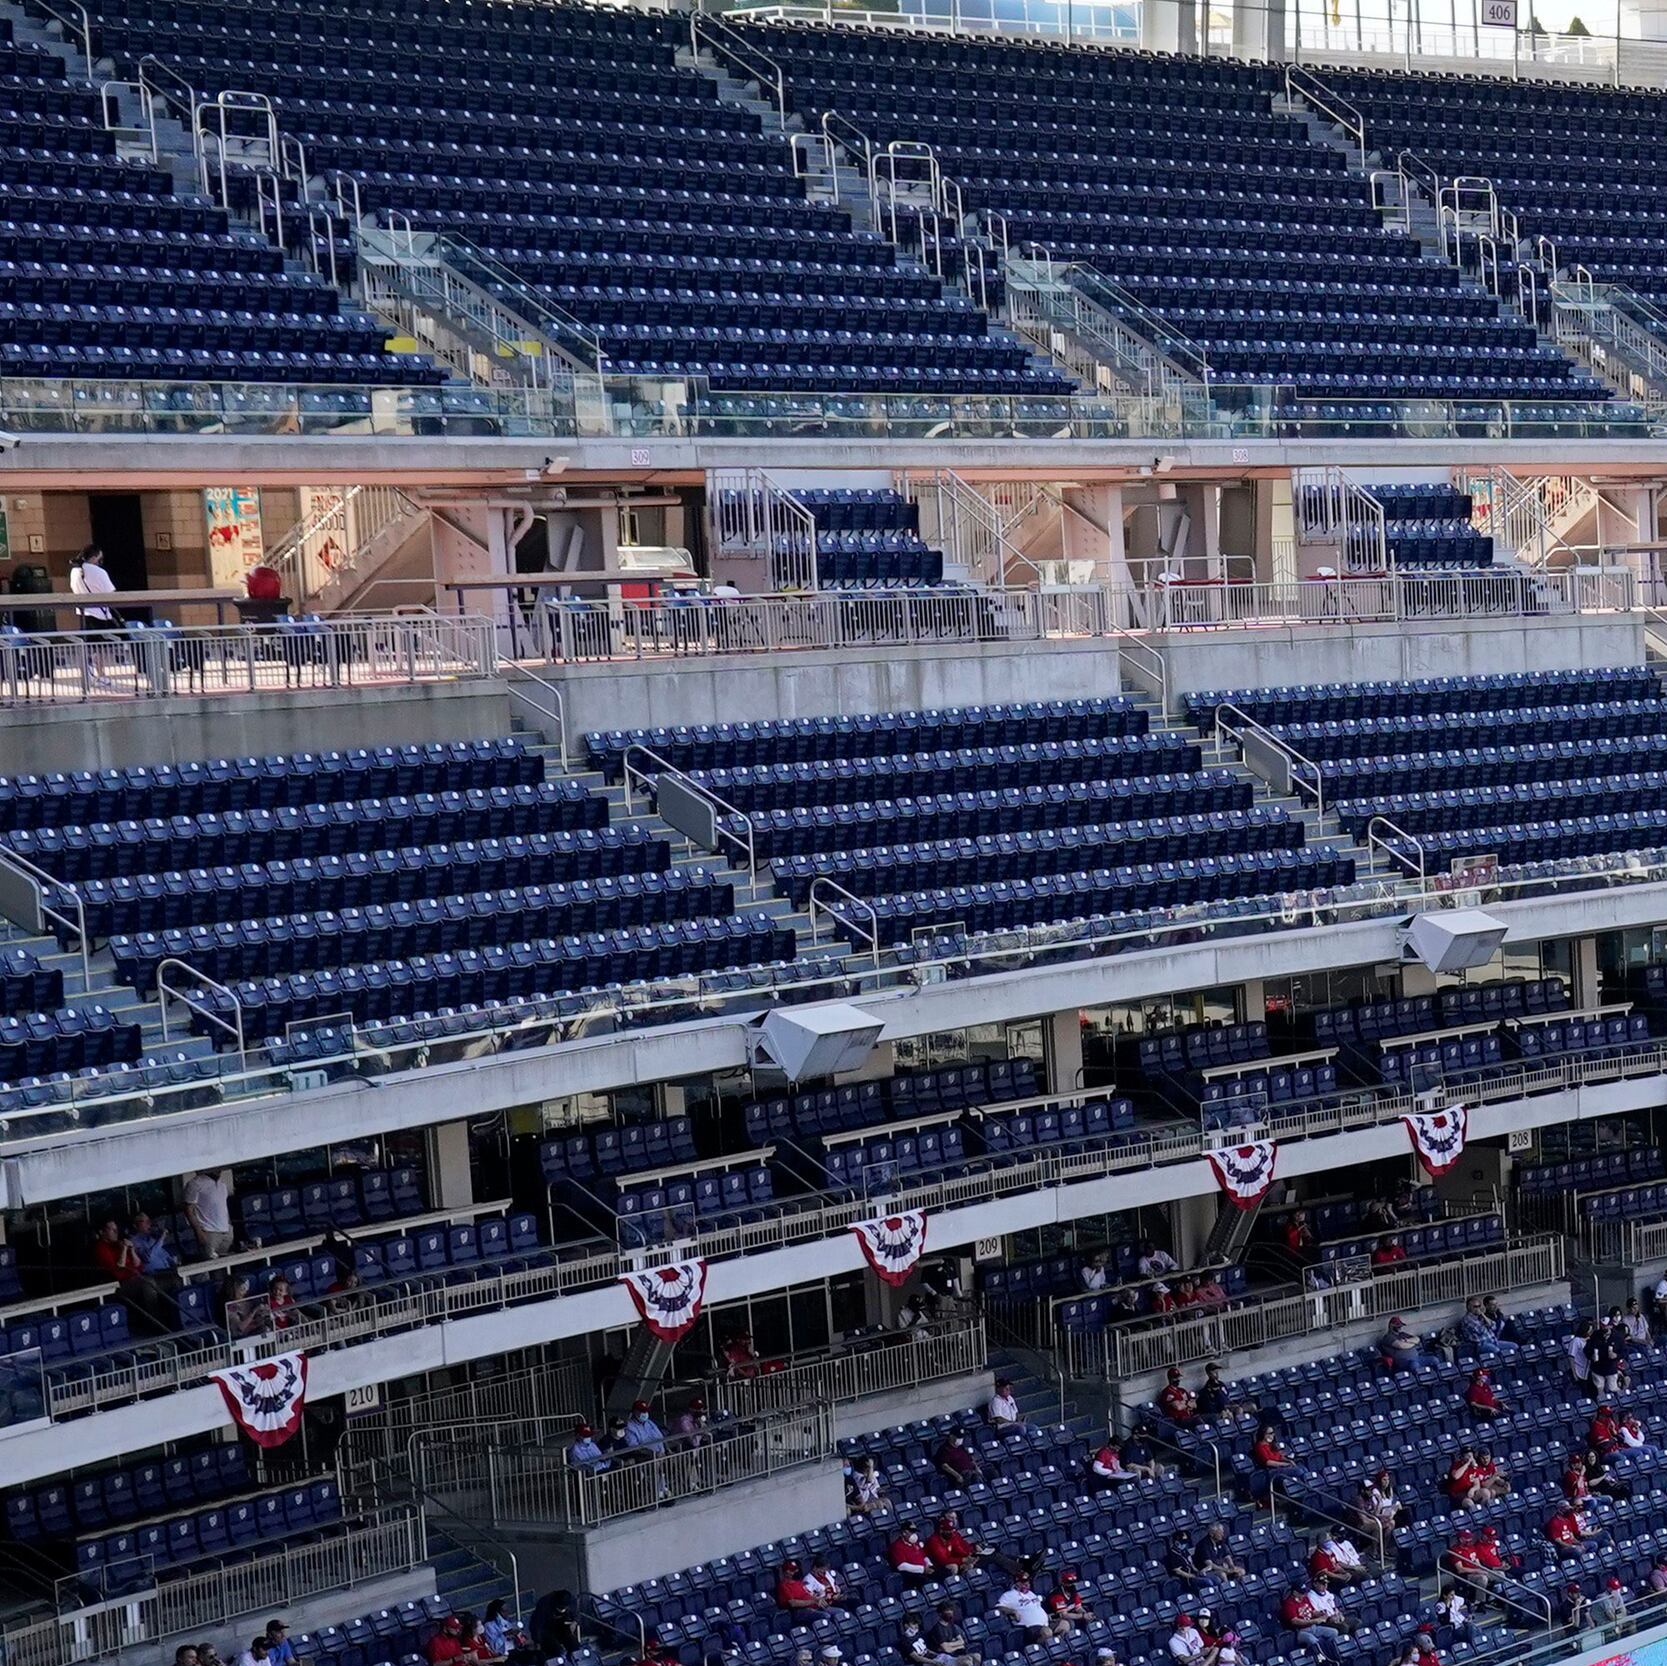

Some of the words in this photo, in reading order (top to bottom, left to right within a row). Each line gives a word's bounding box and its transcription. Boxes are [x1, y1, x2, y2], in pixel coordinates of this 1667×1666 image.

[1489, 7, 1511, 20] 406
[1512, 1132, 1529, 1148] 208
[979, 1237, 997, 1256] 209
[350, 1385, 373, 1406] 210
